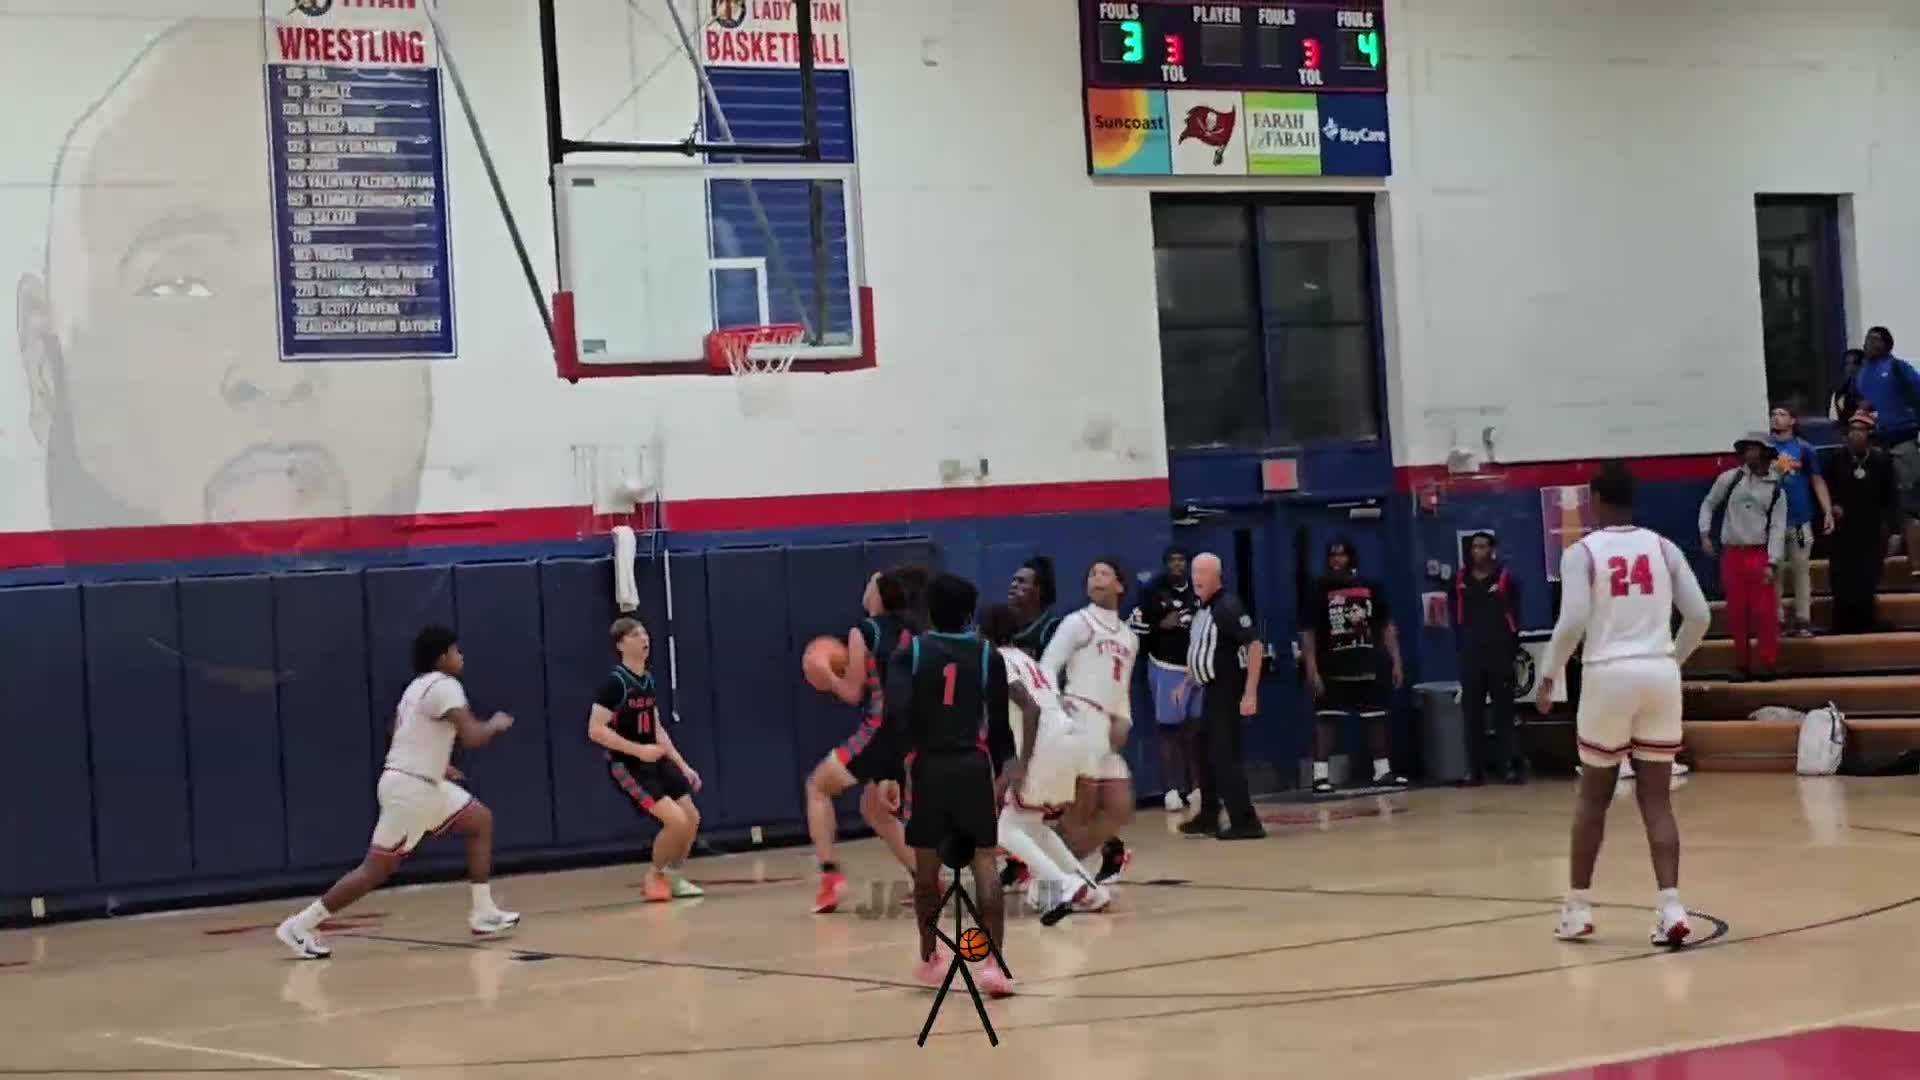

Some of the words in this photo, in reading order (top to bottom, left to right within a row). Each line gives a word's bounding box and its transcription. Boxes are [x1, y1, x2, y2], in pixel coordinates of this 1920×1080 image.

[753, 0, 792, 20] LADY
[813, 2, 841, 22] TAN
[1100, 2, 1140, 20] FOULS
[1193, 6, 1241, 23] PLAYER
[1258, 8, 1296, 25] FOULS
[1337, 11, 1374, 27] FOULS
[277, 27, 425, 63] WRESTLING
[1120, 22, 1144, 63] 3
[1165, 34, 1184, 64] 3
[1358, 32, 1378, 68] 4
[1303, 39, 1321, 68] 3
[1161, 65, 1187, 82] TOL
[1298, 69, 1324, 85] TOL
[1095, 114, 1164, 130] Suncoast
[1253, 112, 1304, 129] FARAH
[1265, 130, 1316, 148] FARAH
[1340, 127, 1386, 145] BayCare
[1608, 554, 1654, 598] 24
[943, 662, 958, 705] 1
